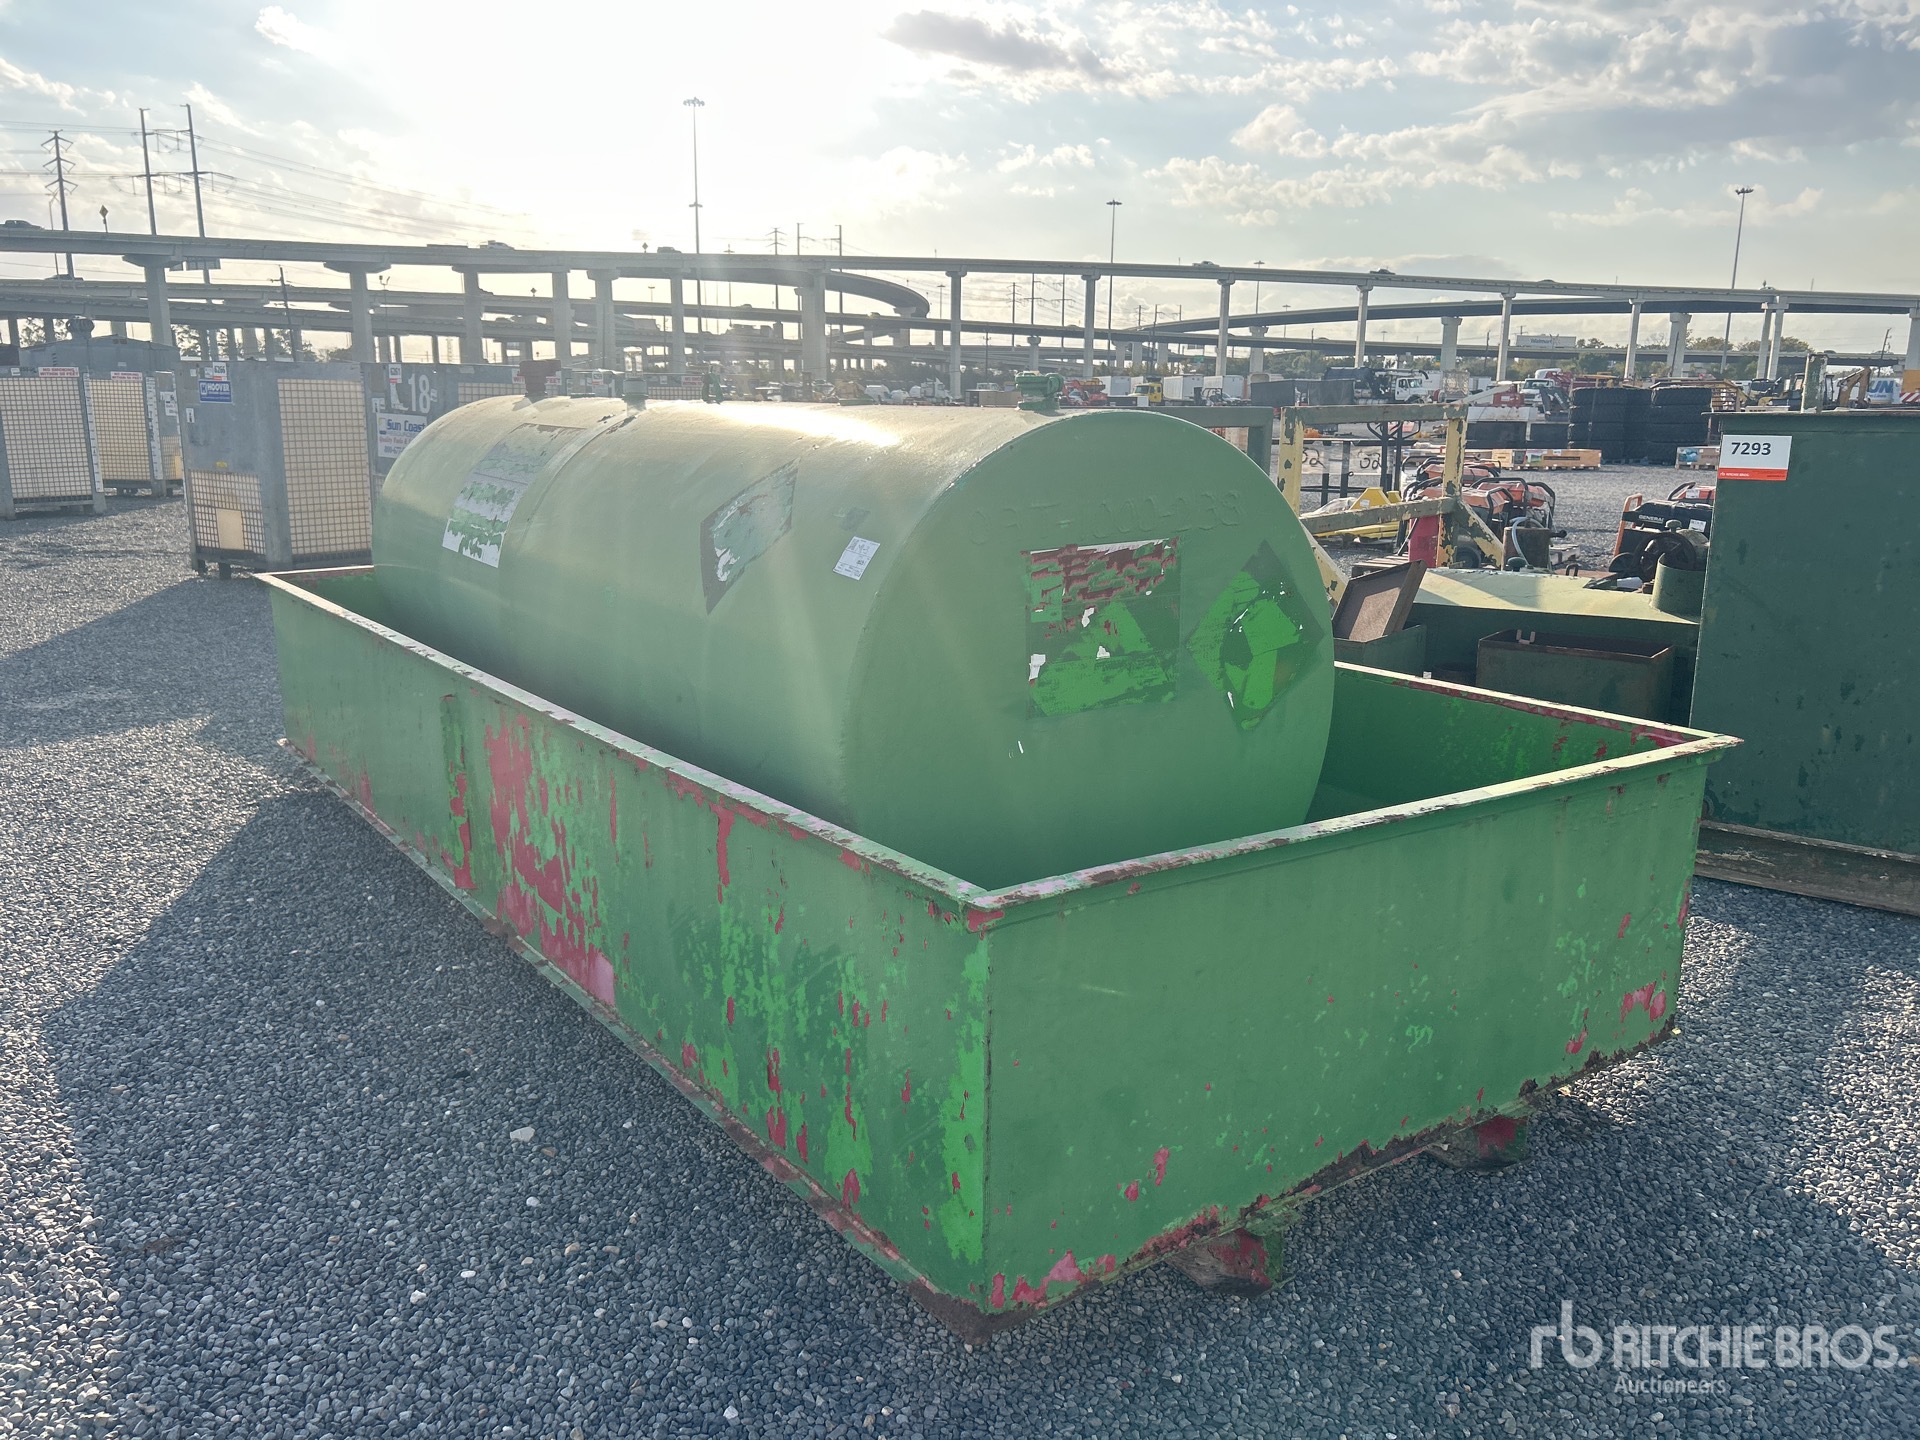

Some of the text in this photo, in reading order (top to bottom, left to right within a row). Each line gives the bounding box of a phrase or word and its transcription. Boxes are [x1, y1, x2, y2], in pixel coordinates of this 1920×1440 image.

[208, 383, 230, 391] HOOVER
[387, 419, 426, 432] Sun Coast
[1731, 442, 1771, 455] 7293
